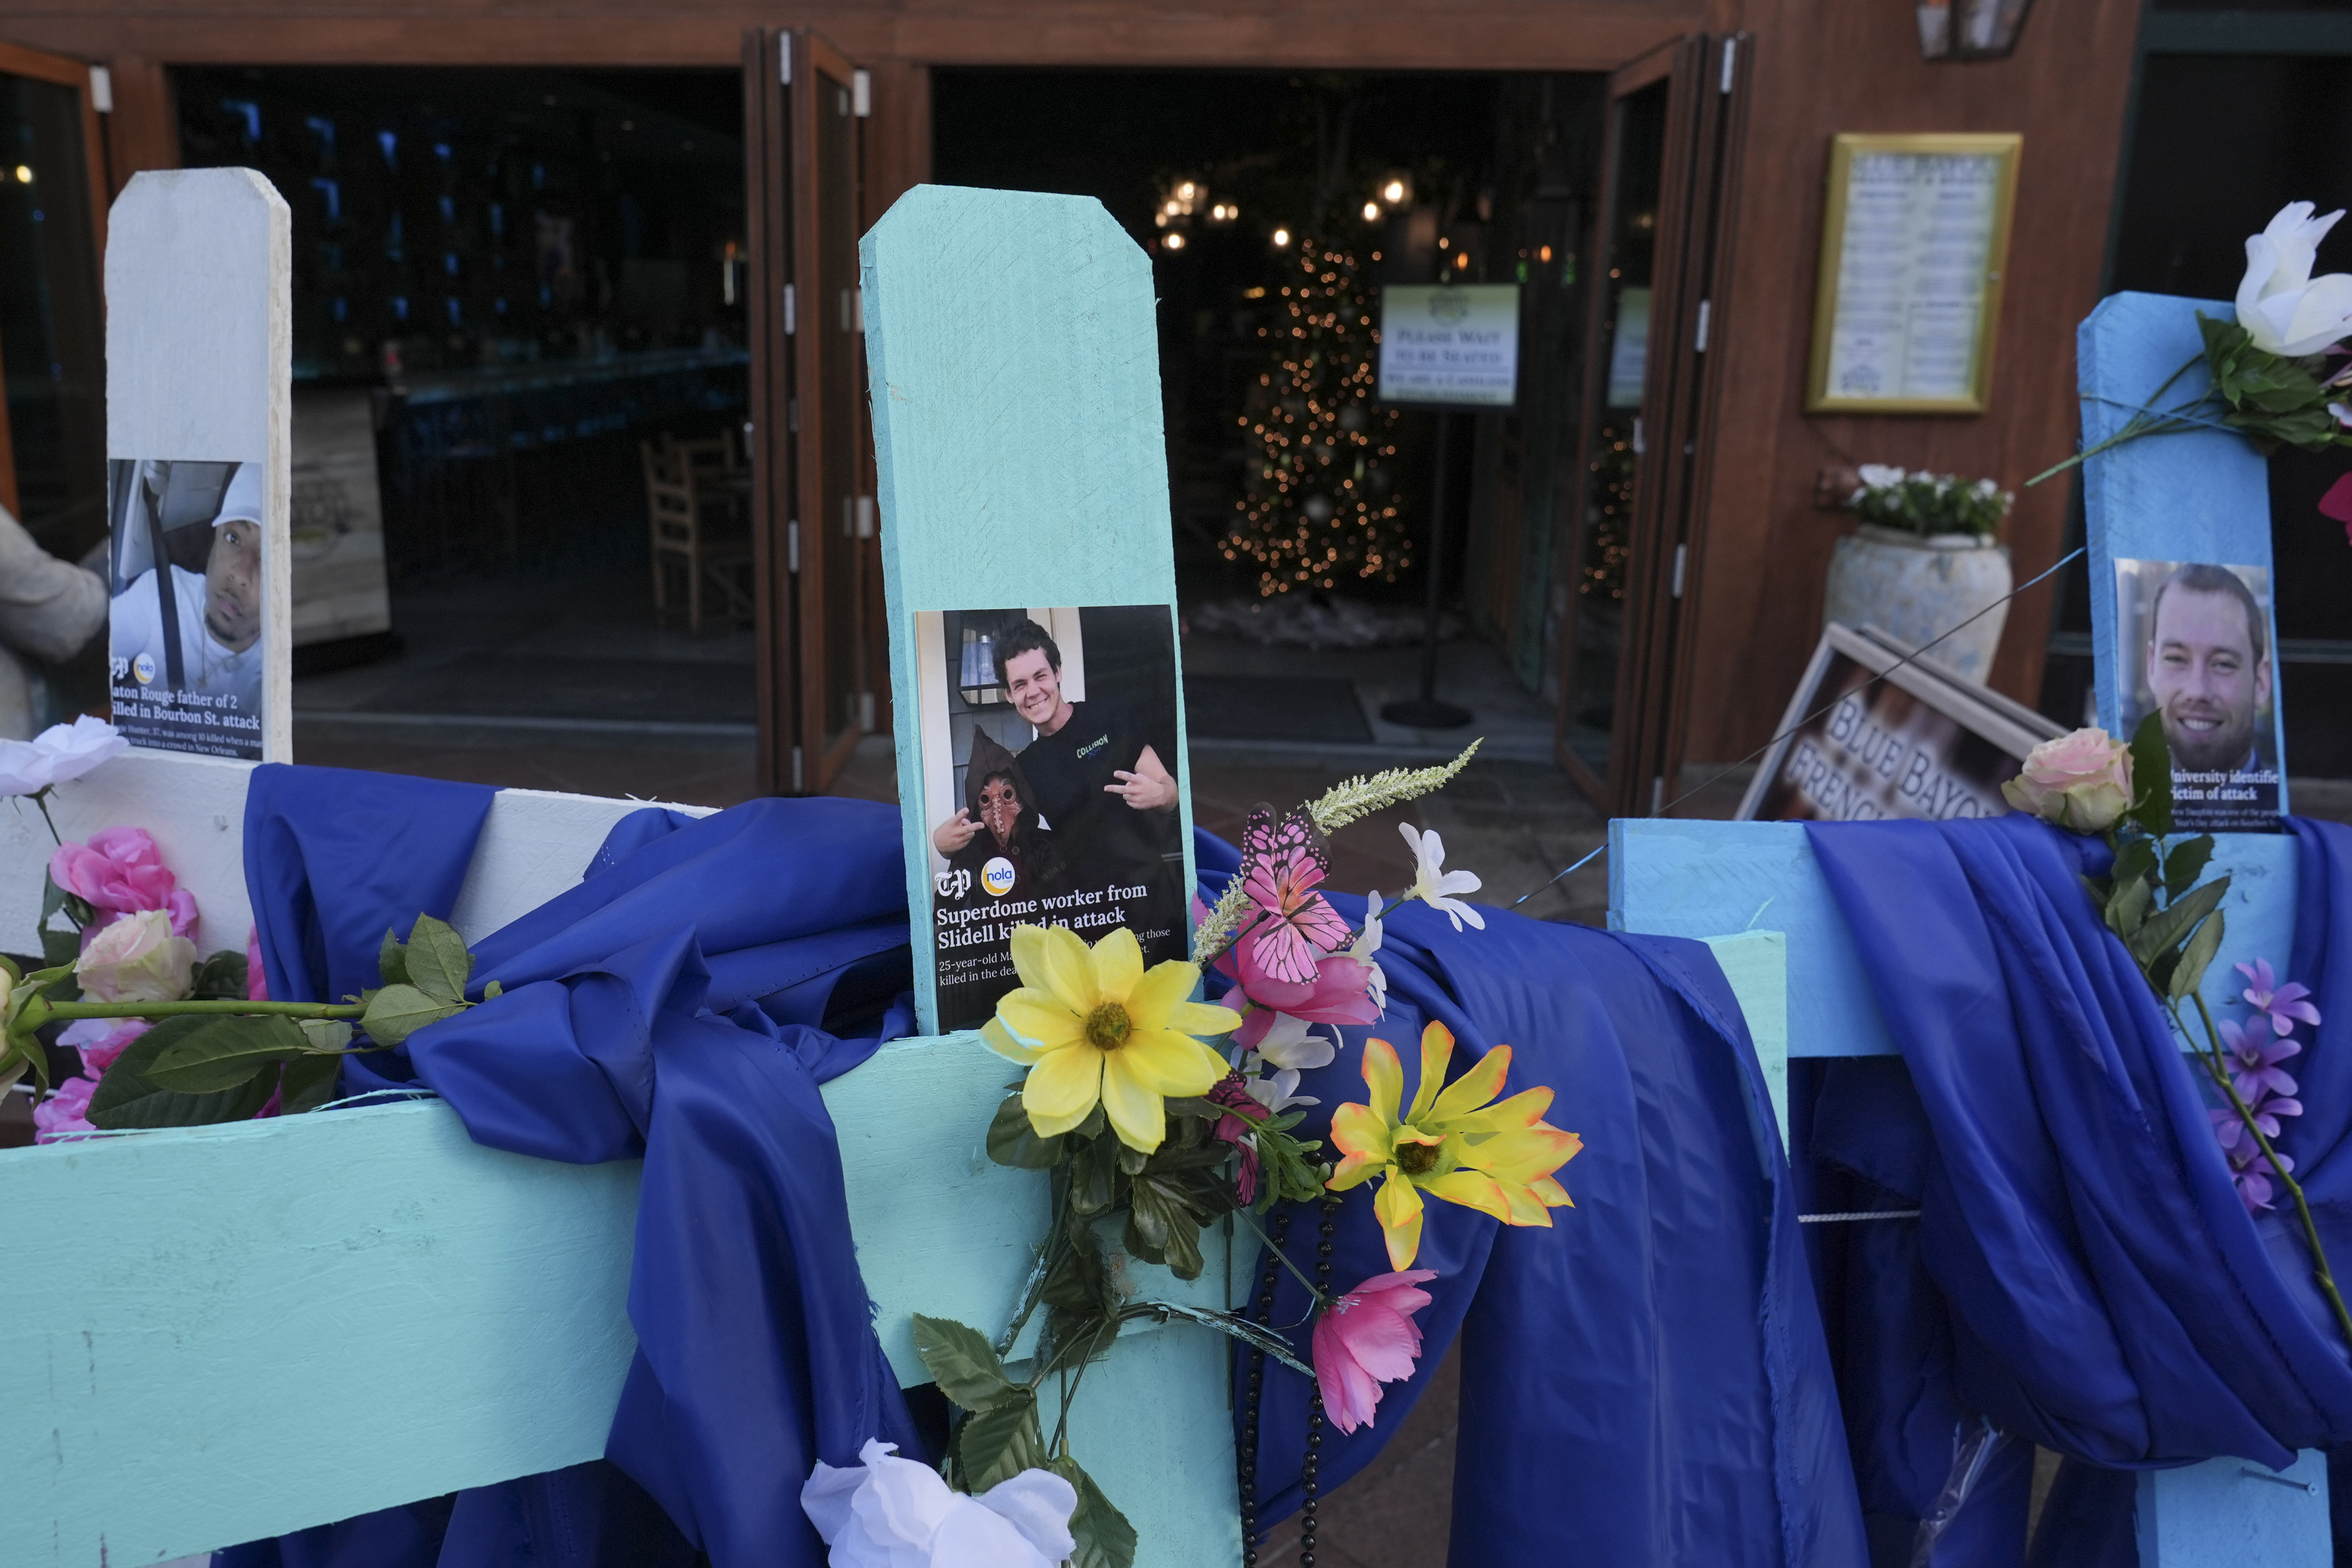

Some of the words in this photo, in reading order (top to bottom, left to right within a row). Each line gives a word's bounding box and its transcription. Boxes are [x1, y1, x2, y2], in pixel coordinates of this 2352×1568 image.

[113, 686, 139, 699] aton
[141, 686, 175, 705] Rouge
[177, 689, 213, 707] father
[215, 694, 229, 708] of
[230, 695, 237, 709] 2
[112, 700, 137, 717] illed
[140, 703, 152, 719] in
[153, 705, 202, 724] Bourbon
[204, 711, 220, 726] St.
[223, 715, 260, 730] attack
[195, 744, 210, 753] New
[206, 732, 225, 744] killed
[225, 735, 244, 746] when
[1077, 734, 1108, 759] COLLISION
[1831, 700, 1903, 778] BLUE
[1901, 750, 1989, 820] BAYO
[2229, 769, 2279, 784] identifie
[2206, 786, 2220, 800] of
[2220, 786, 2258, 801] attack
[987, 868, 1012, 882] nola
[937, 900, 1037, 928] Superdome
[1042, 889, 1103, 910] worker
[1108, 884, 1148, 902] from
[938, 924, 995, 949] Slidell
[1074, 906, 1126, 929] attack
[939, 952, 998, 972] 25-year-old
[1146, 929, 1171, 939] those
[940, 972, 966, 986] killed
[969, 971, 979, 982] in
[981, 969, 998, 979] the
